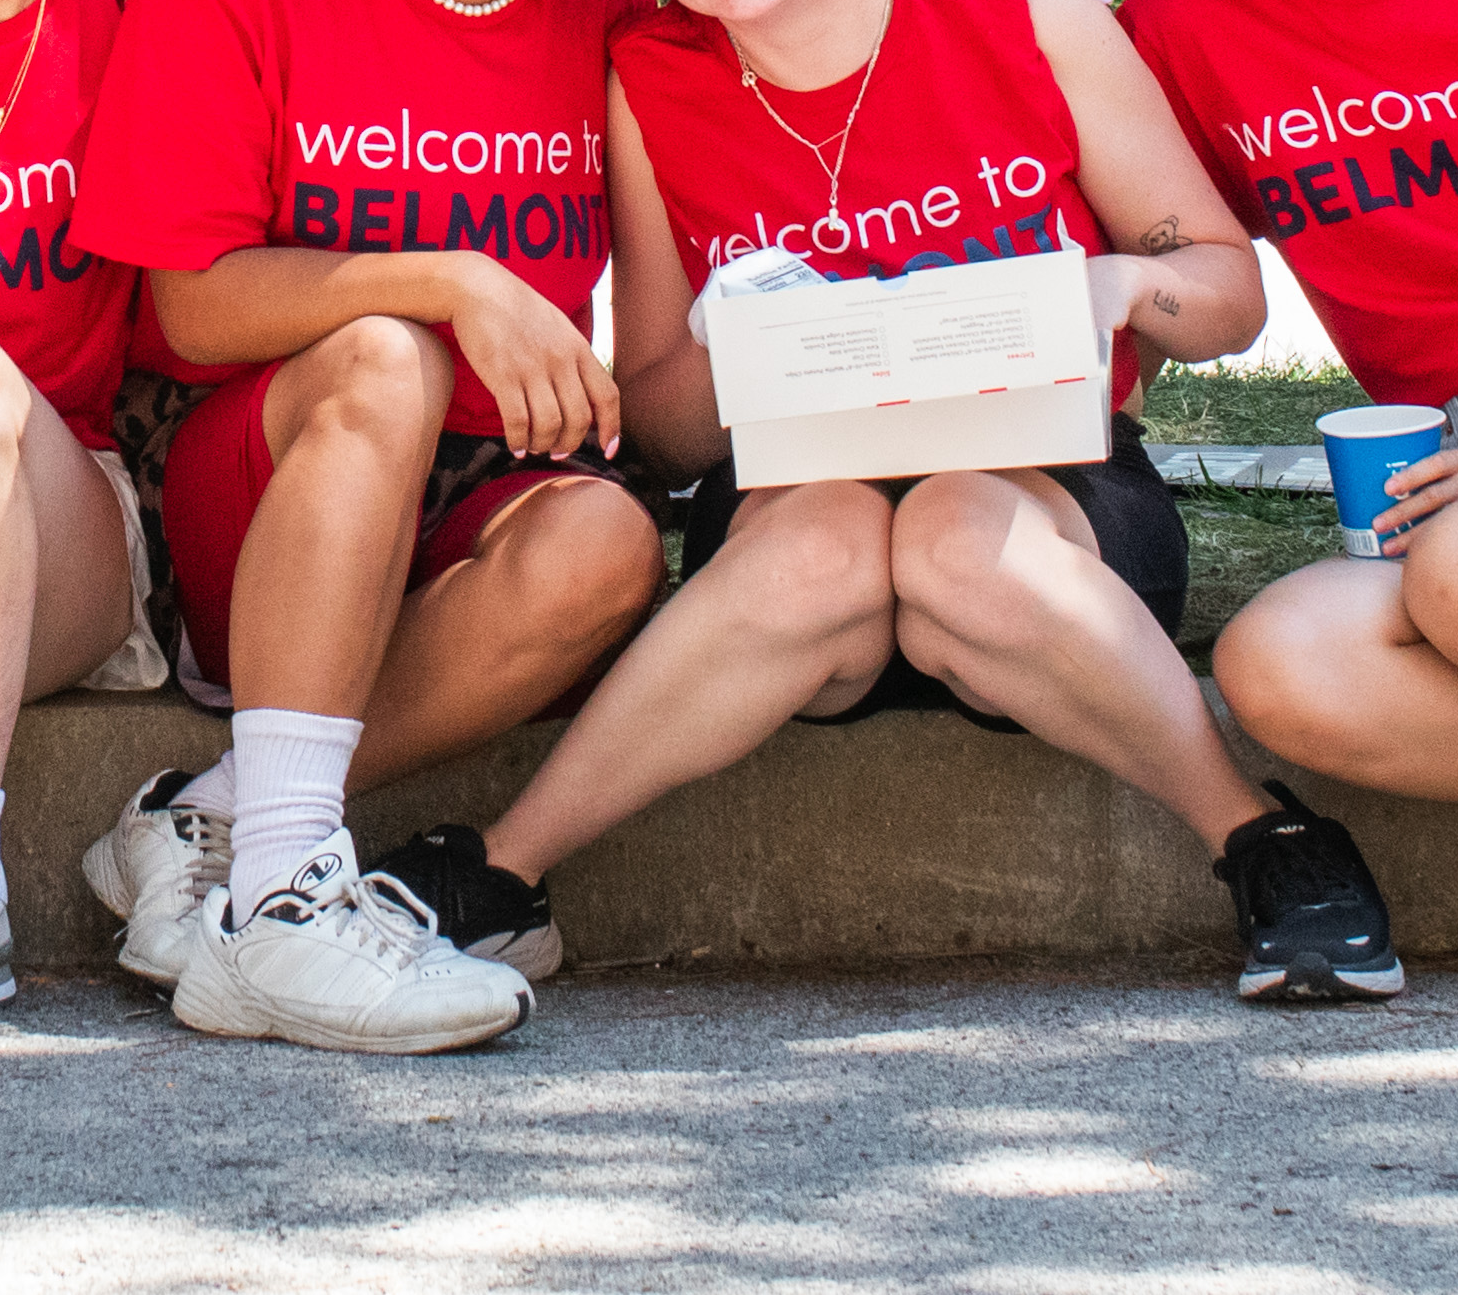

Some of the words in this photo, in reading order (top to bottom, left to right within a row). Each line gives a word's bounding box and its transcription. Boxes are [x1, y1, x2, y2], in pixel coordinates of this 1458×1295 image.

[296, 108, 572, 176] welcome
[978, 156, 1046, 208] to
[292, 182, 604, 260] BELMONT
